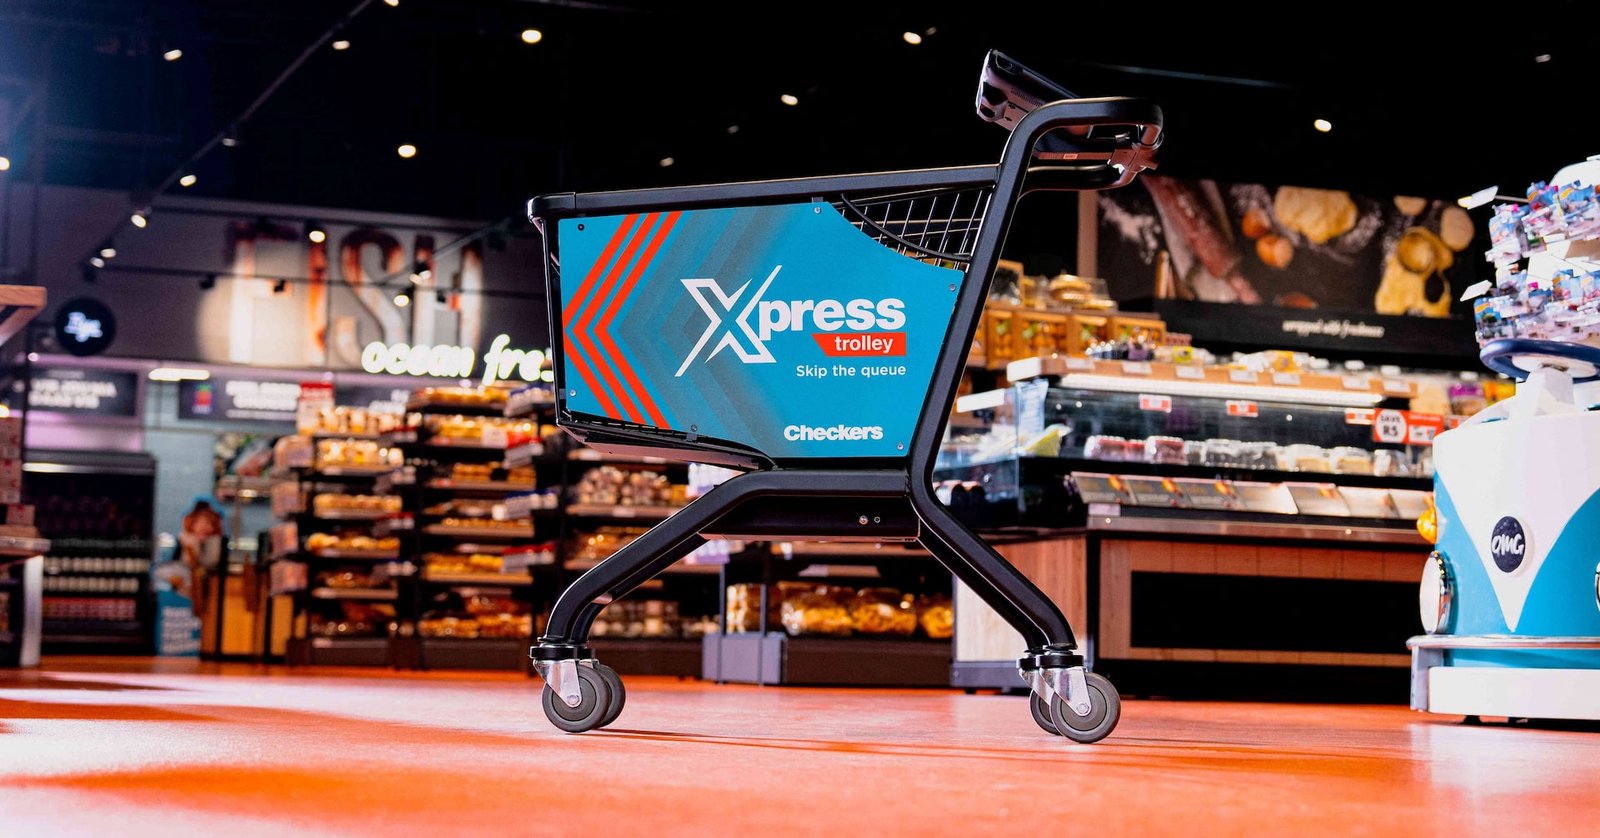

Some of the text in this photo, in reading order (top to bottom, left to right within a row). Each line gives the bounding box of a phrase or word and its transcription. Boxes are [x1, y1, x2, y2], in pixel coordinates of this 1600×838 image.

[227, 222, 482, 374] FISH
[674, 264, 906, 377] Xpress
[834, 334, 894, 354] trolley
[360, 341, 475, 377] ocean
[796, 364, 906, 380] Skip the queue
[783, 423, 884, 441] Checkers
[1492, 533, 1525, 557] OMG
